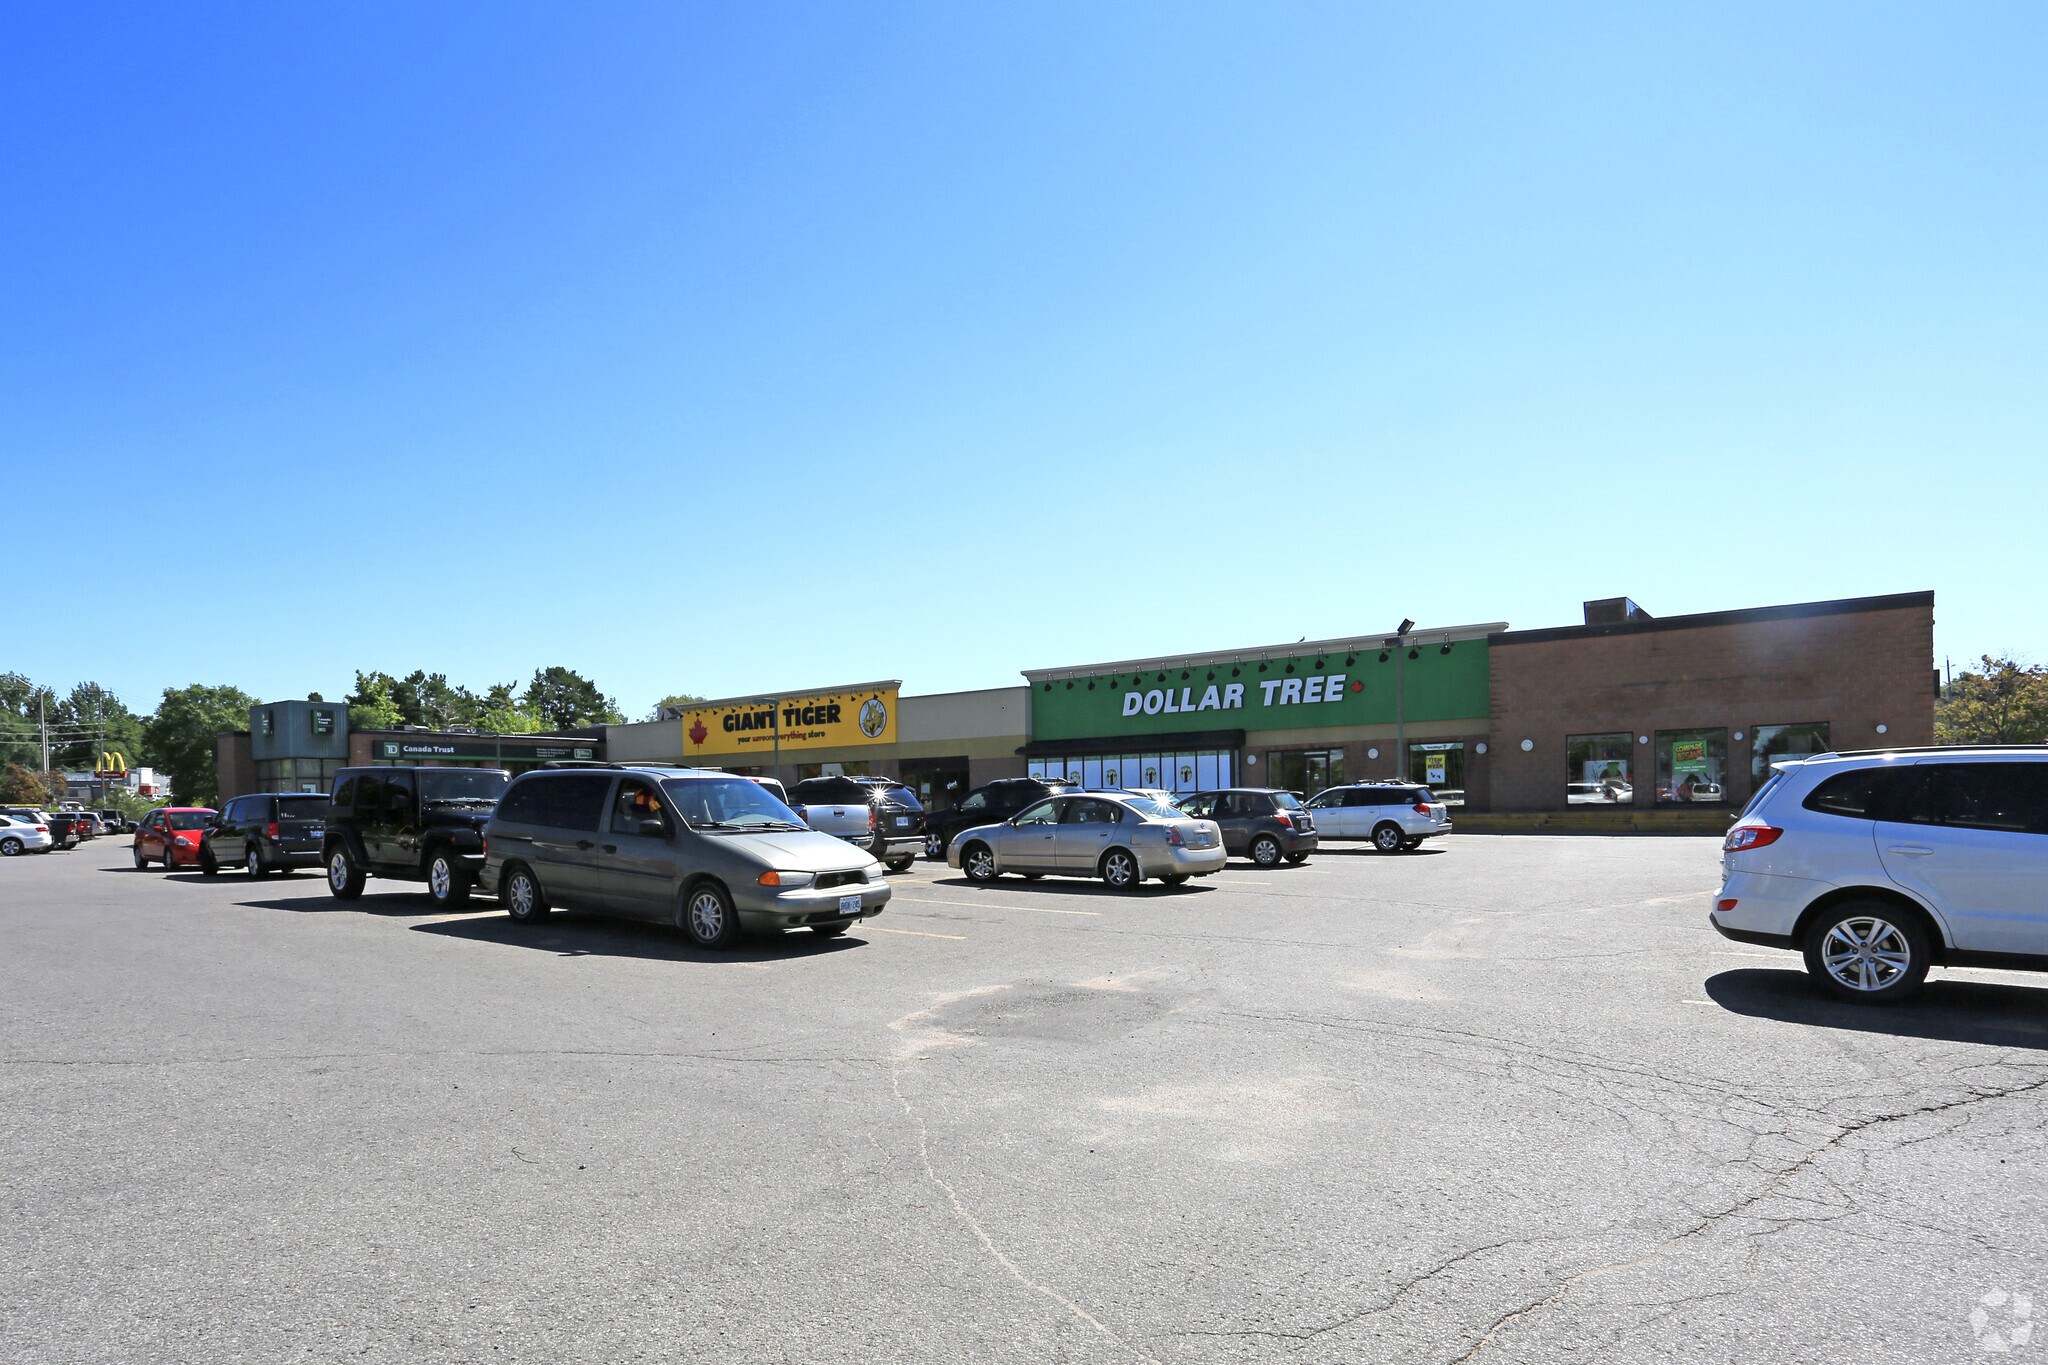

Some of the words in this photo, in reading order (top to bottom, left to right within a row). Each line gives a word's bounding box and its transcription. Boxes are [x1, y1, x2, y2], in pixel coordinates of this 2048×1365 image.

[1122, 682, 1245, 716] DOLLAR
[1259, 674, 1347, 706] TREE
[723, 711, 776, 732] GIANT
[783, 705, 841, 727] TIGER
[737, 736, 751, 745] your
[808, 730, 826, 738] store
[386, 744, 398, 754] TD
[403, 745, 432, 753] Canada
[1675, 743, 1704, 752] COMPARE
